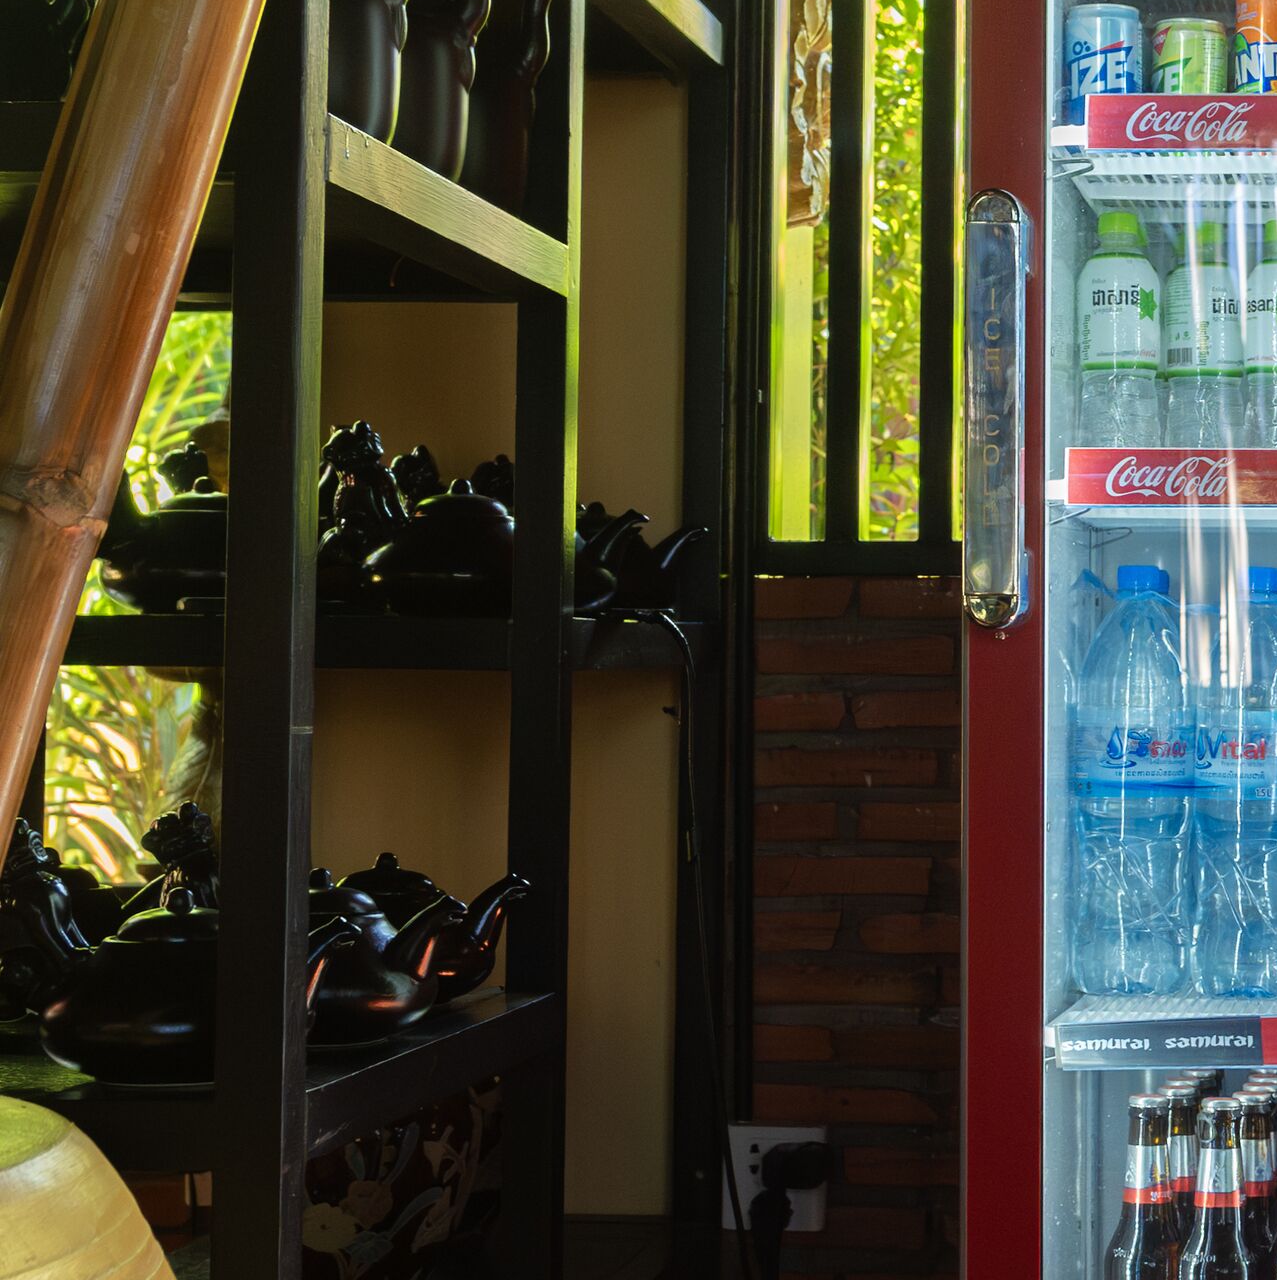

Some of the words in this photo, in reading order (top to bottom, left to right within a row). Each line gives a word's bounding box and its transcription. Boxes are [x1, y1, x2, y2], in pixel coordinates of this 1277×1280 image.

[1126, 101, 1255, 142] Coca-Cola
[1105, 456, 1237, 498] Coca-Cola
[1207, 729, 1266, 760] Vital
[1062, 1037, 1150, 1052] samurai
[1165, 1035, 1254, 1050] samurai
